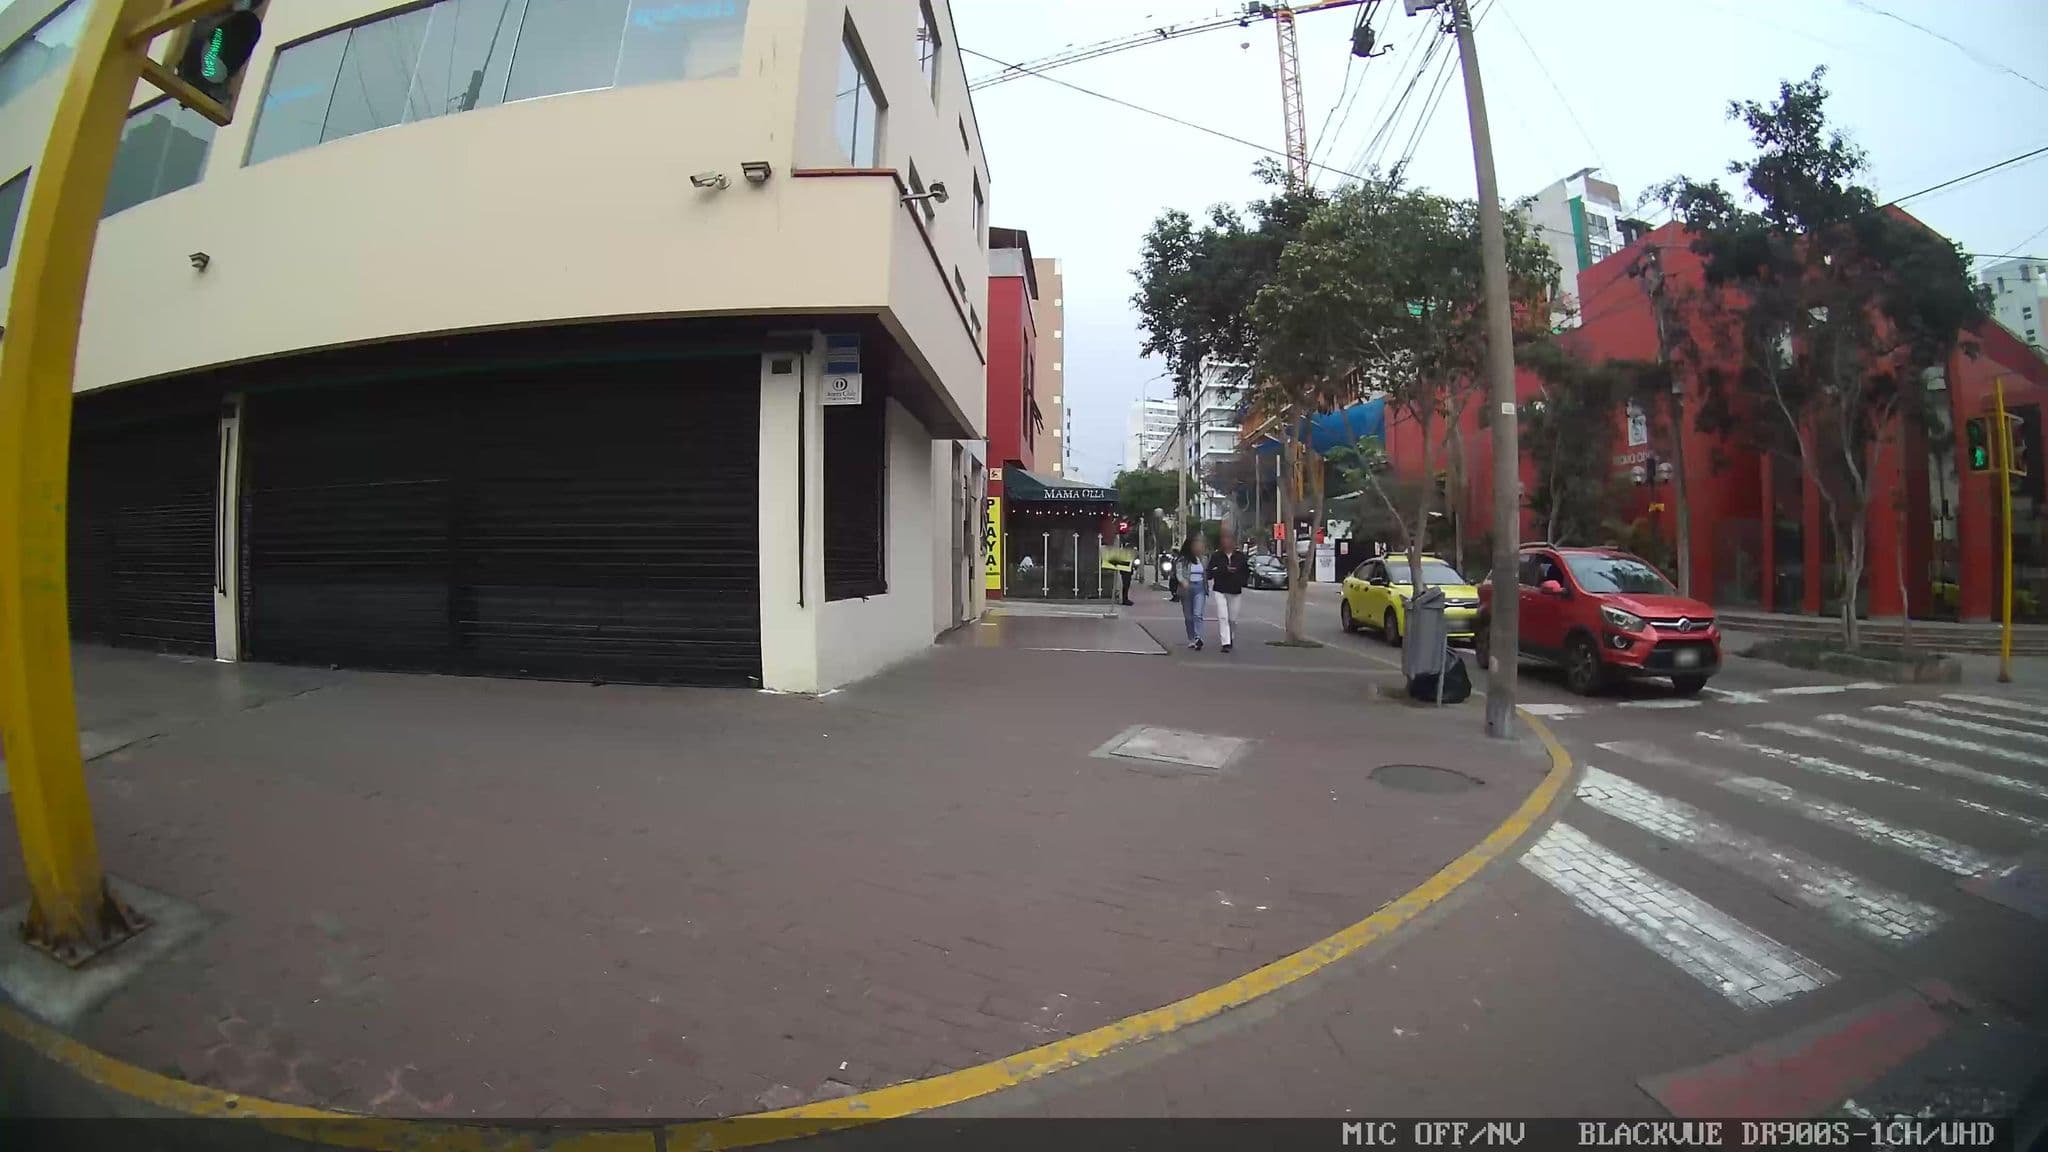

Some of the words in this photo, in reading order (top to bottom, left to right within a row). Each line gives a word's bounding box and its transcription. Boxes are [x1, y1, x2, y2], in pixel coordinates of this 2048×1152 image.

[1044, 489, 1080, 499] MAMA
[1081, 489, 1105, 499] OLLA
[986, 499, 997, 567] PLAYA
